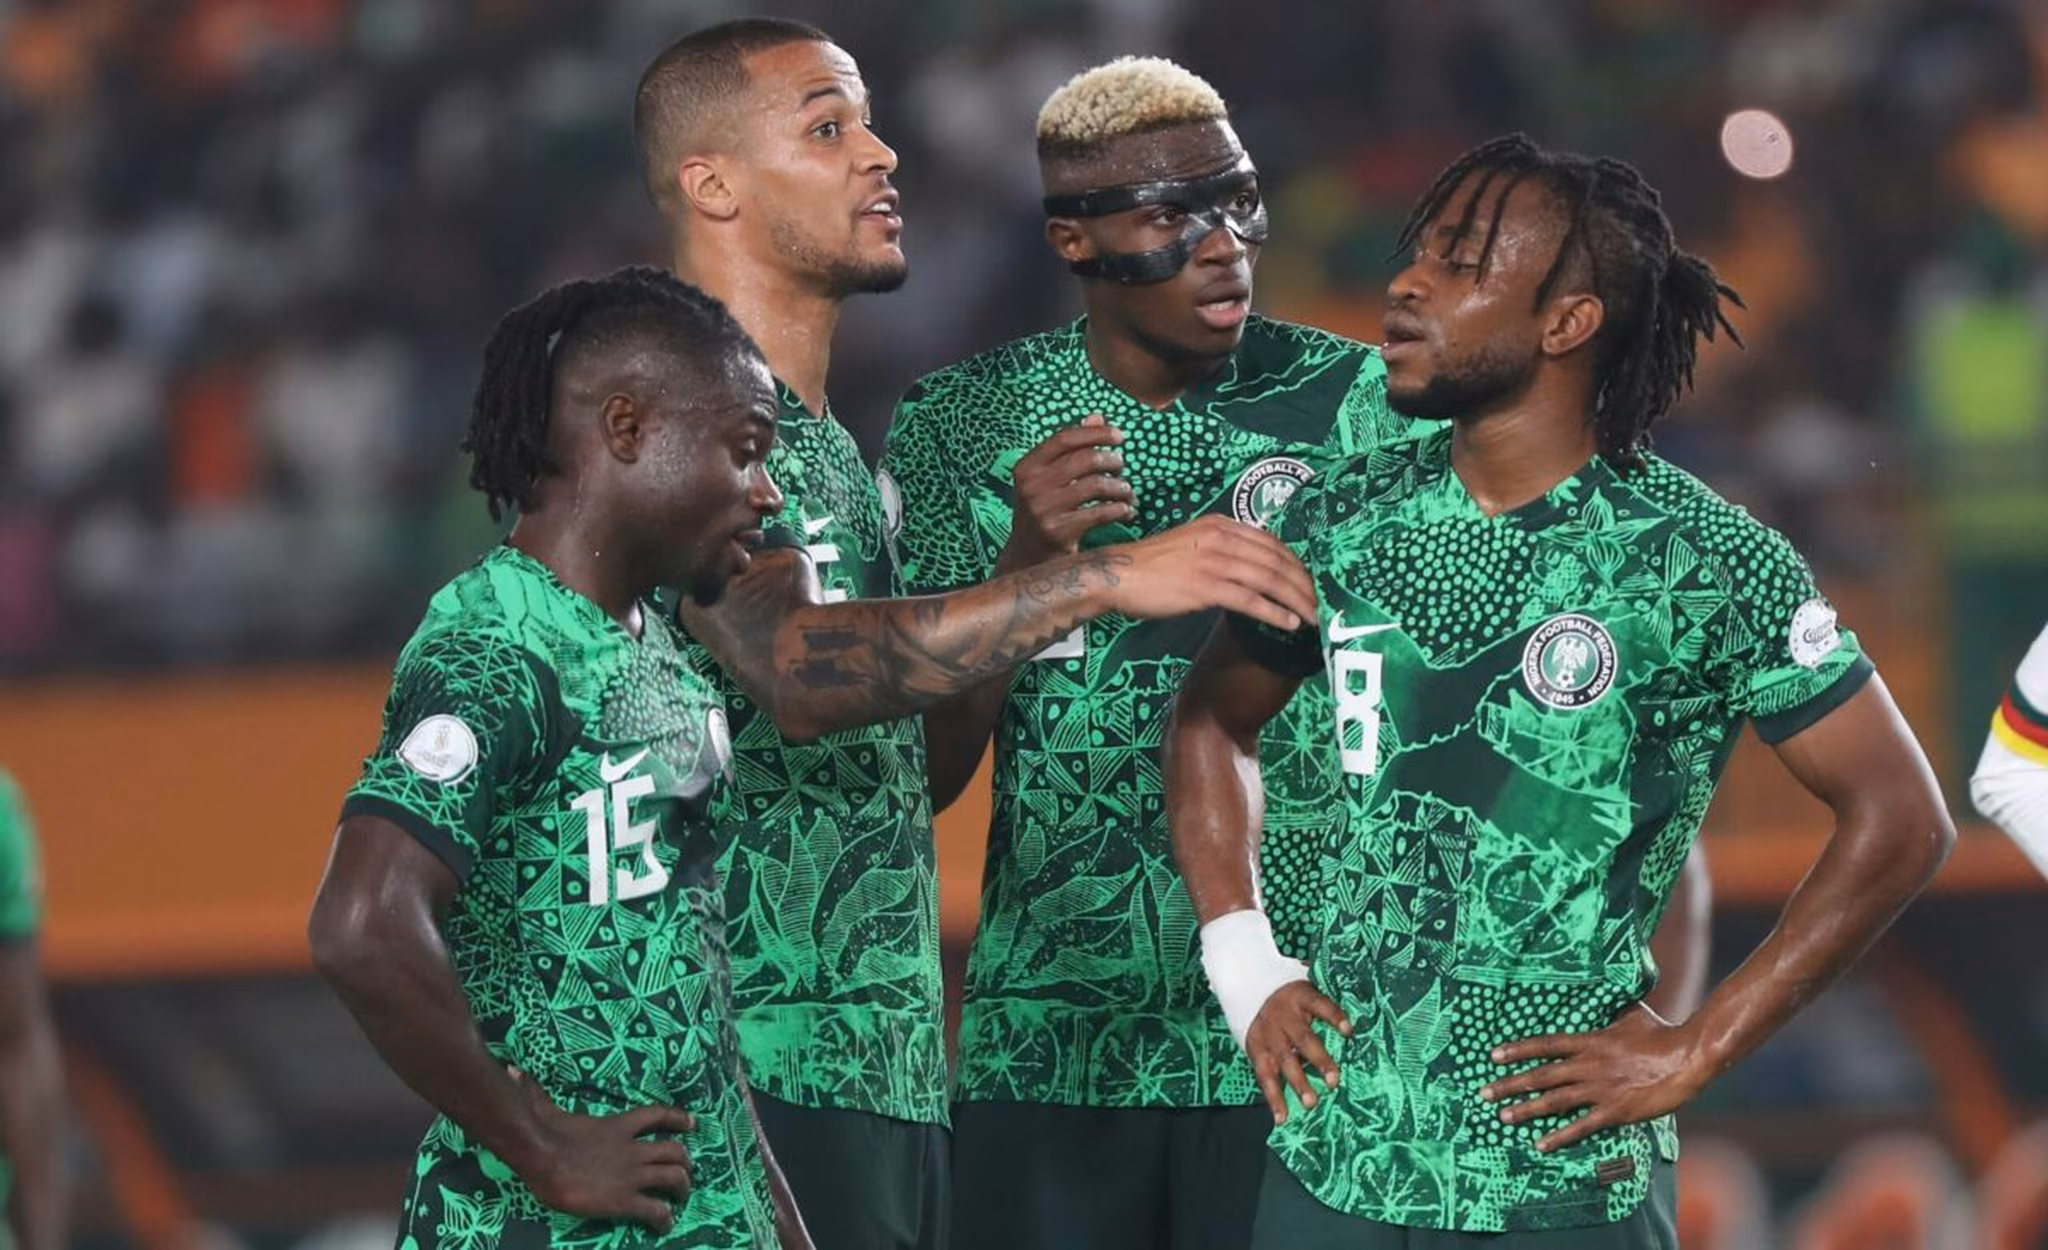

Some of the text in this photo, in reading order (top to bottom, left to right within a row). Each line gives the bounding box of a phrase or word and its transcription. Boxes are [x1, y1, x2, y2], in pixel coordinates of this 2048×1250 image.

[1238, 463, 1295, 528] IGERIA FOOTBALL
[1529, 619, 1612, 697] NIGERIA FOOTBALL FEDERATION
[1334, 649, 1383, 775] 8
[1549, 691, 1575, 704] 1945
[570, 773, 670, 906] 15
